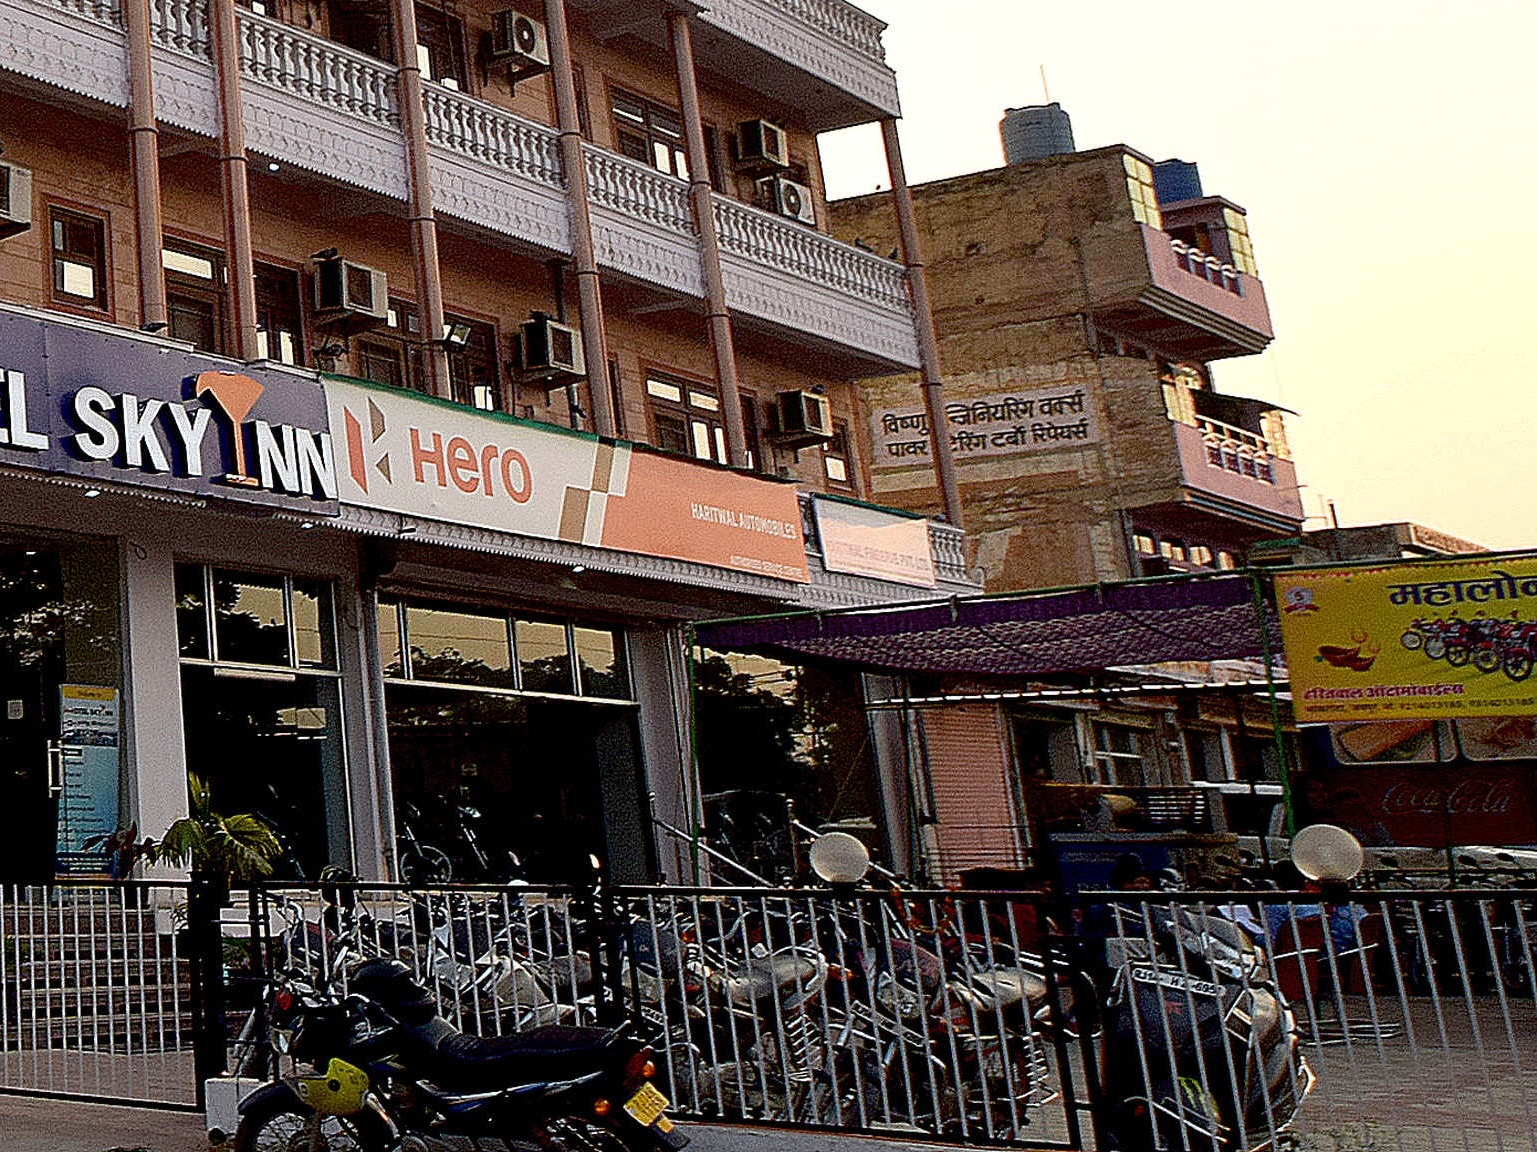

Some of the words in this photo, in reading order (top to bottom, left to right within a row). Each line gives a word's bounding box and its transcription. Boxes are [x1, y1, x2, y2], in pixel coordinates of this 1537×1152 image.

[74, 386, 213, 477] SKY
[886, 439, 928, 457] पावर
[690, 502, 739, 528] HARITWAL
